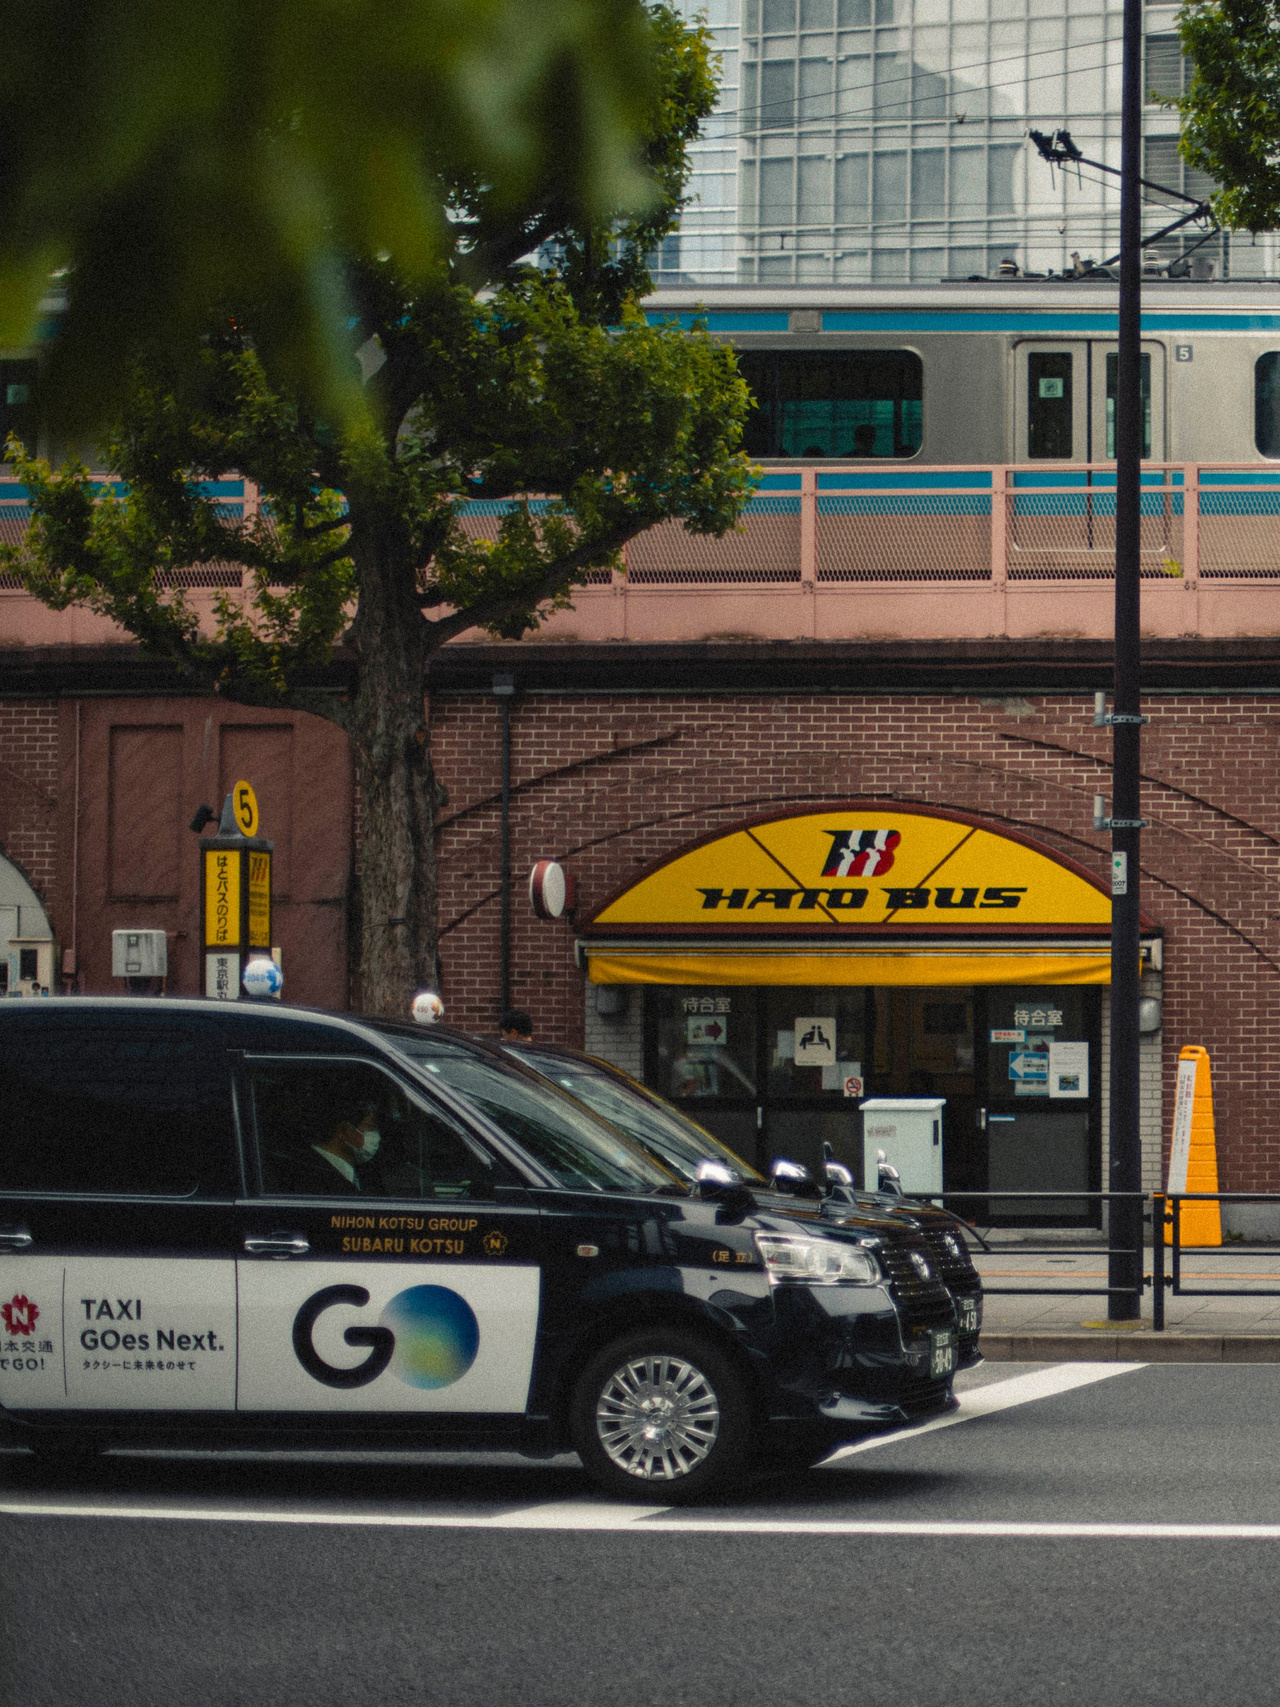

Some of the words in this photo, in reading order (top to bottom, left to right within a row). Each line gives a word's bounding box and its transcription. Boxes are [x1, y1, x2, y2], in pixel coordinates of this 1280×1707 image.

[1179, 347, 1190, 360] 5
[239, 790, 254, 828] 5
[216, 855, 229, 942] はとバスのりば
[695, 887, 869, 909] HATO
[880, 887, 1028, 909] BUS
[682, 998, 731, 1013] 待合室
[1013, 1009, 1063, 1026] 待合室
[330, 1216, 375, 1229] NIHON
[379, 1217, 424, 1231] KOTSU
[428, 1218, 478, 1231] GROUP
[342, 1237, 403, 1253] SUBARU
[410, 1239, 464, 1254] KOTSU
[81, 1299, 141, 1321] TAXI
[0, 1340, 53, 1353] 本交通
[80, 1329, 150, 1351] GOes
[156, 1329, 224, 1351] Next.
[83, 1360, 196, 1371] タクシーに未来をのせて
